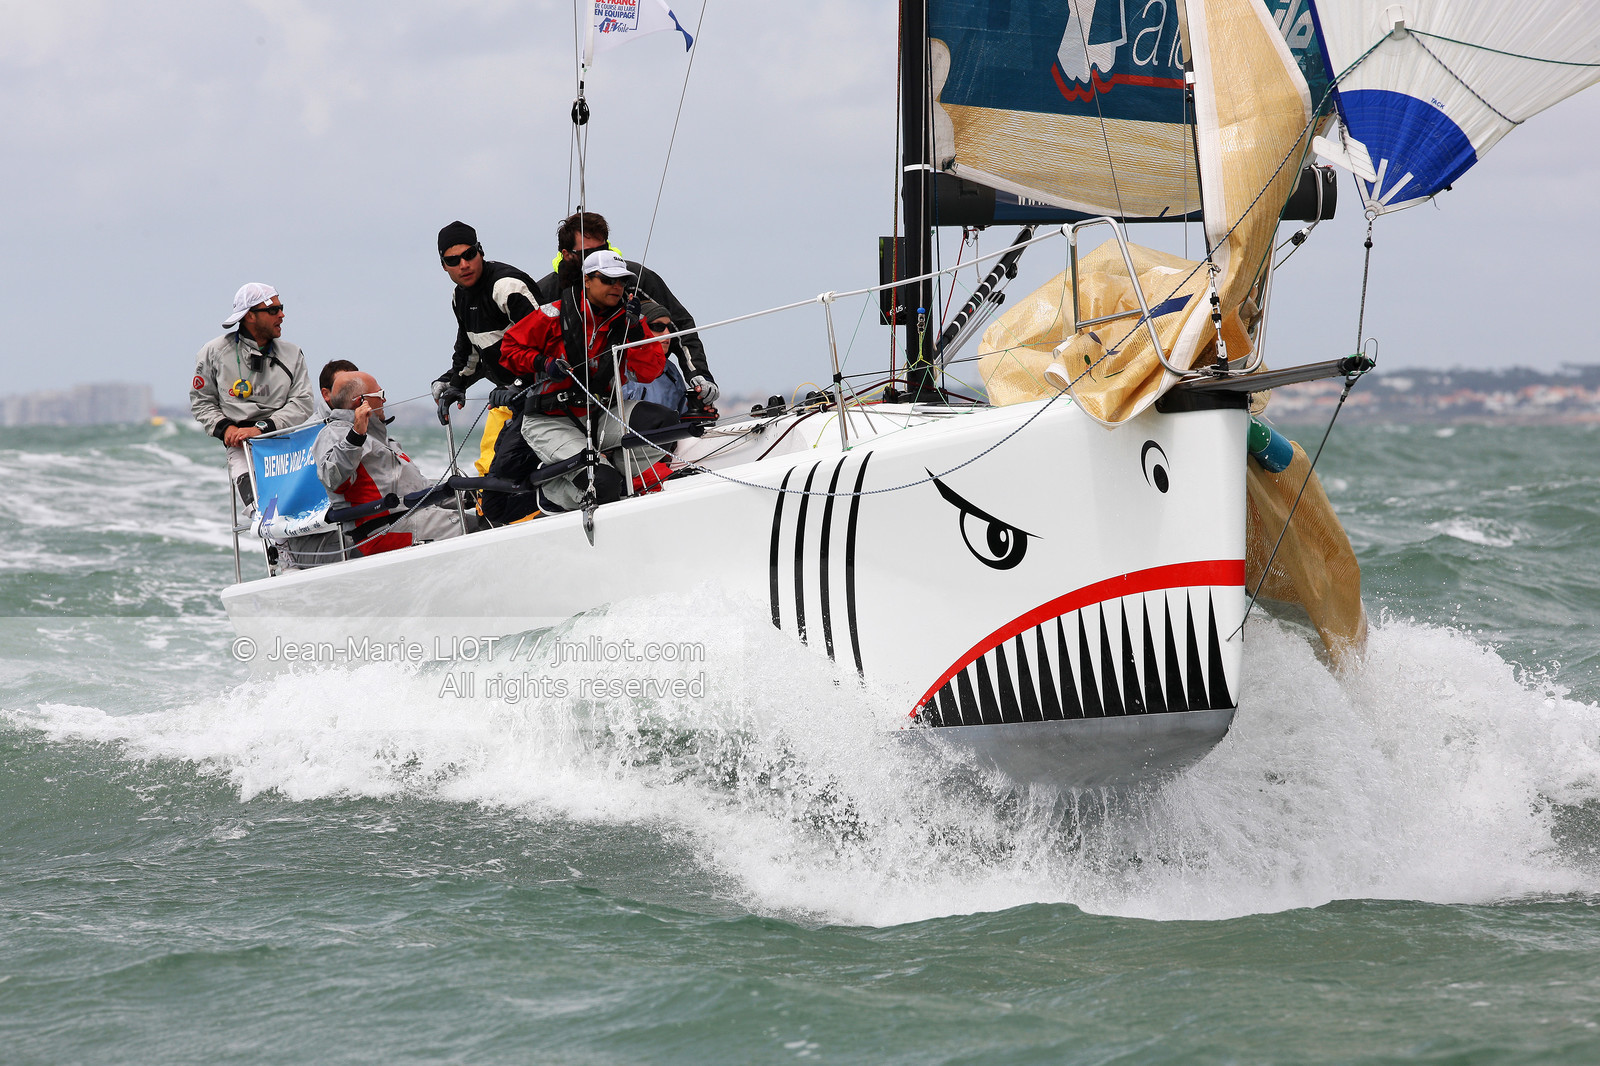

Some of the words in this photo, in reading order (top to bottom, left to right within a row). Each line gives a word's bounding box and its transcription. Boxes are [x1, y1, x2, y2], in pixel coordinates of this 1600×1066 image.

[604, 10, 636, 19] EQUIPAGE
[1430, 97, 1445, 110] TACK
[264, 453, 290, 478] BIENNE
